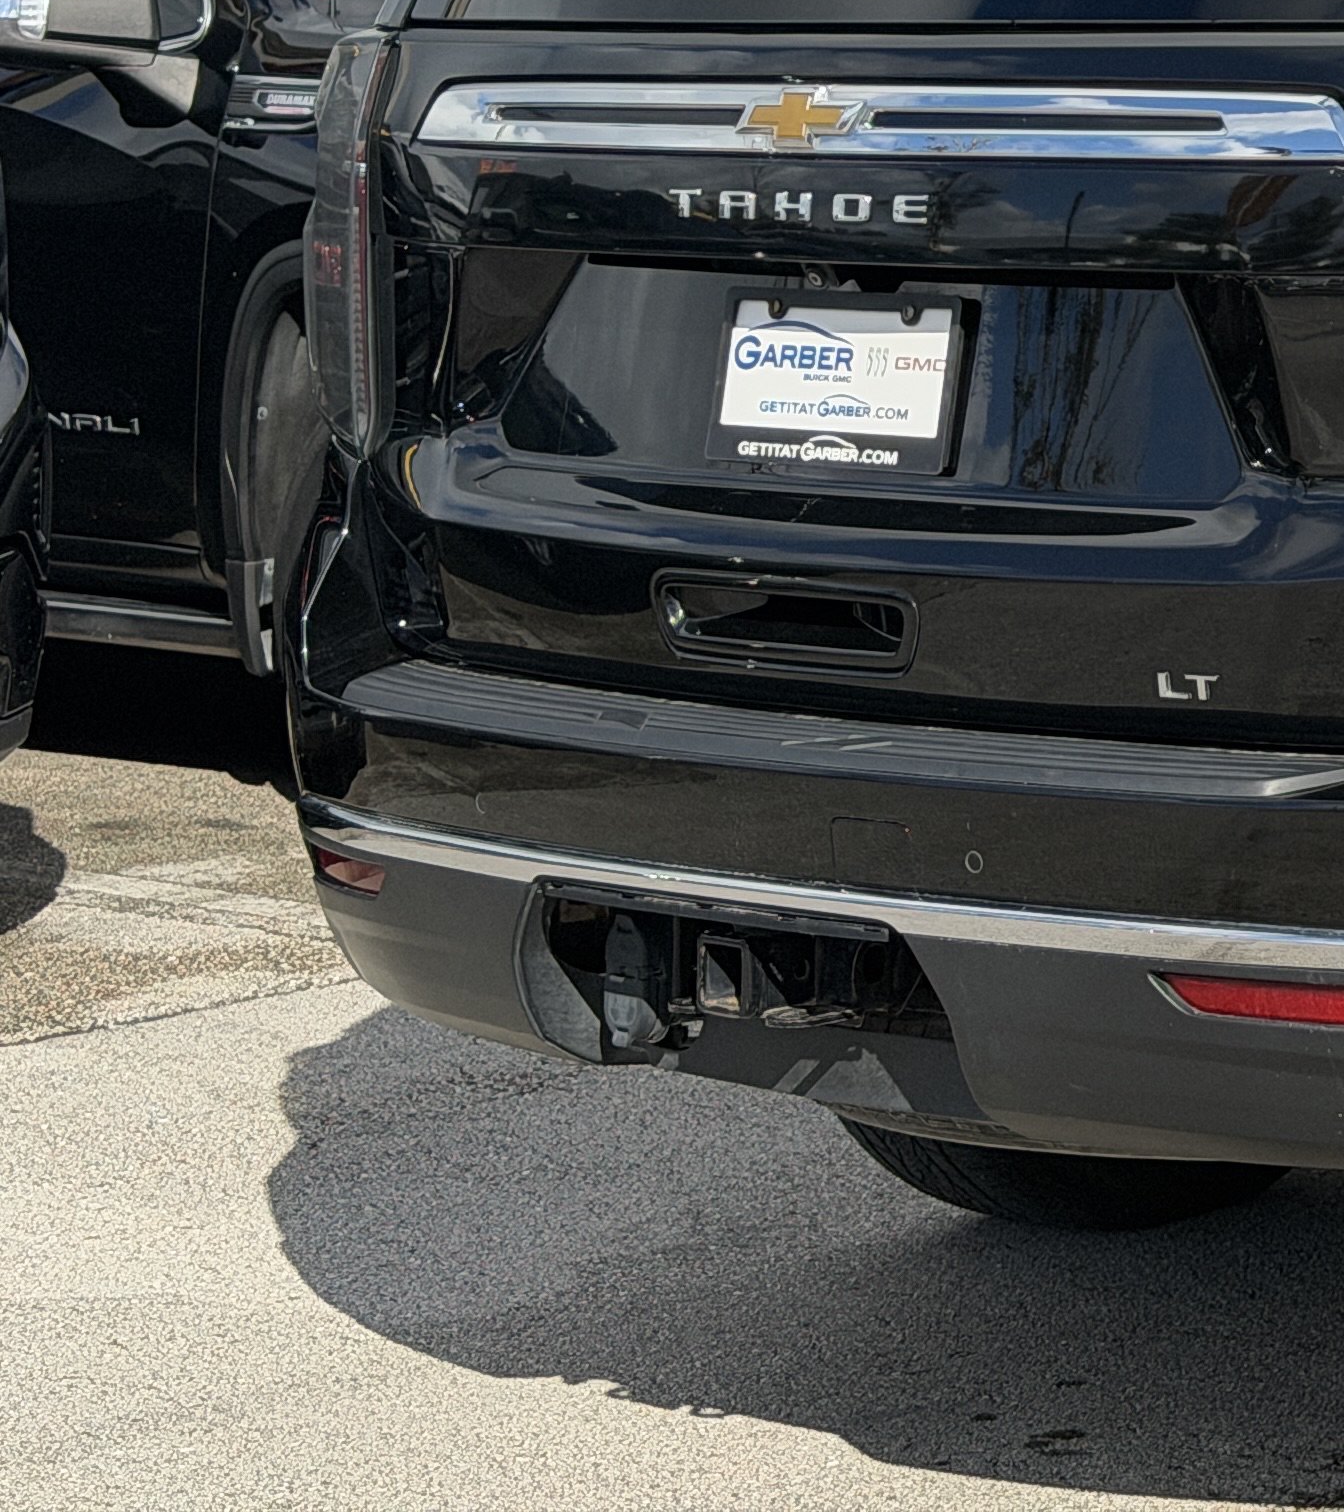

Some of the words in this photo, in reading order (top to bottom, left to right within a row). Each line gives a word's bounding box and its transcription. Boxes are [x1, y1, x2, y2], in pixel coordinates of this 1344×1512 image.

[668, 188, 931, 224] TAHOE
[734, 335, 854, 372] GARBER
[894, 356, 946, 372] GMC
[803, 373, 830, 382] BUICK
[832, 374, 852, 384] GMC
[759, 399, 909, 421] GETITATGARBER.COM
[737, 440, 899, 465] GETITATGARBER.COM
[1156, 671, 1220, 701] LT
